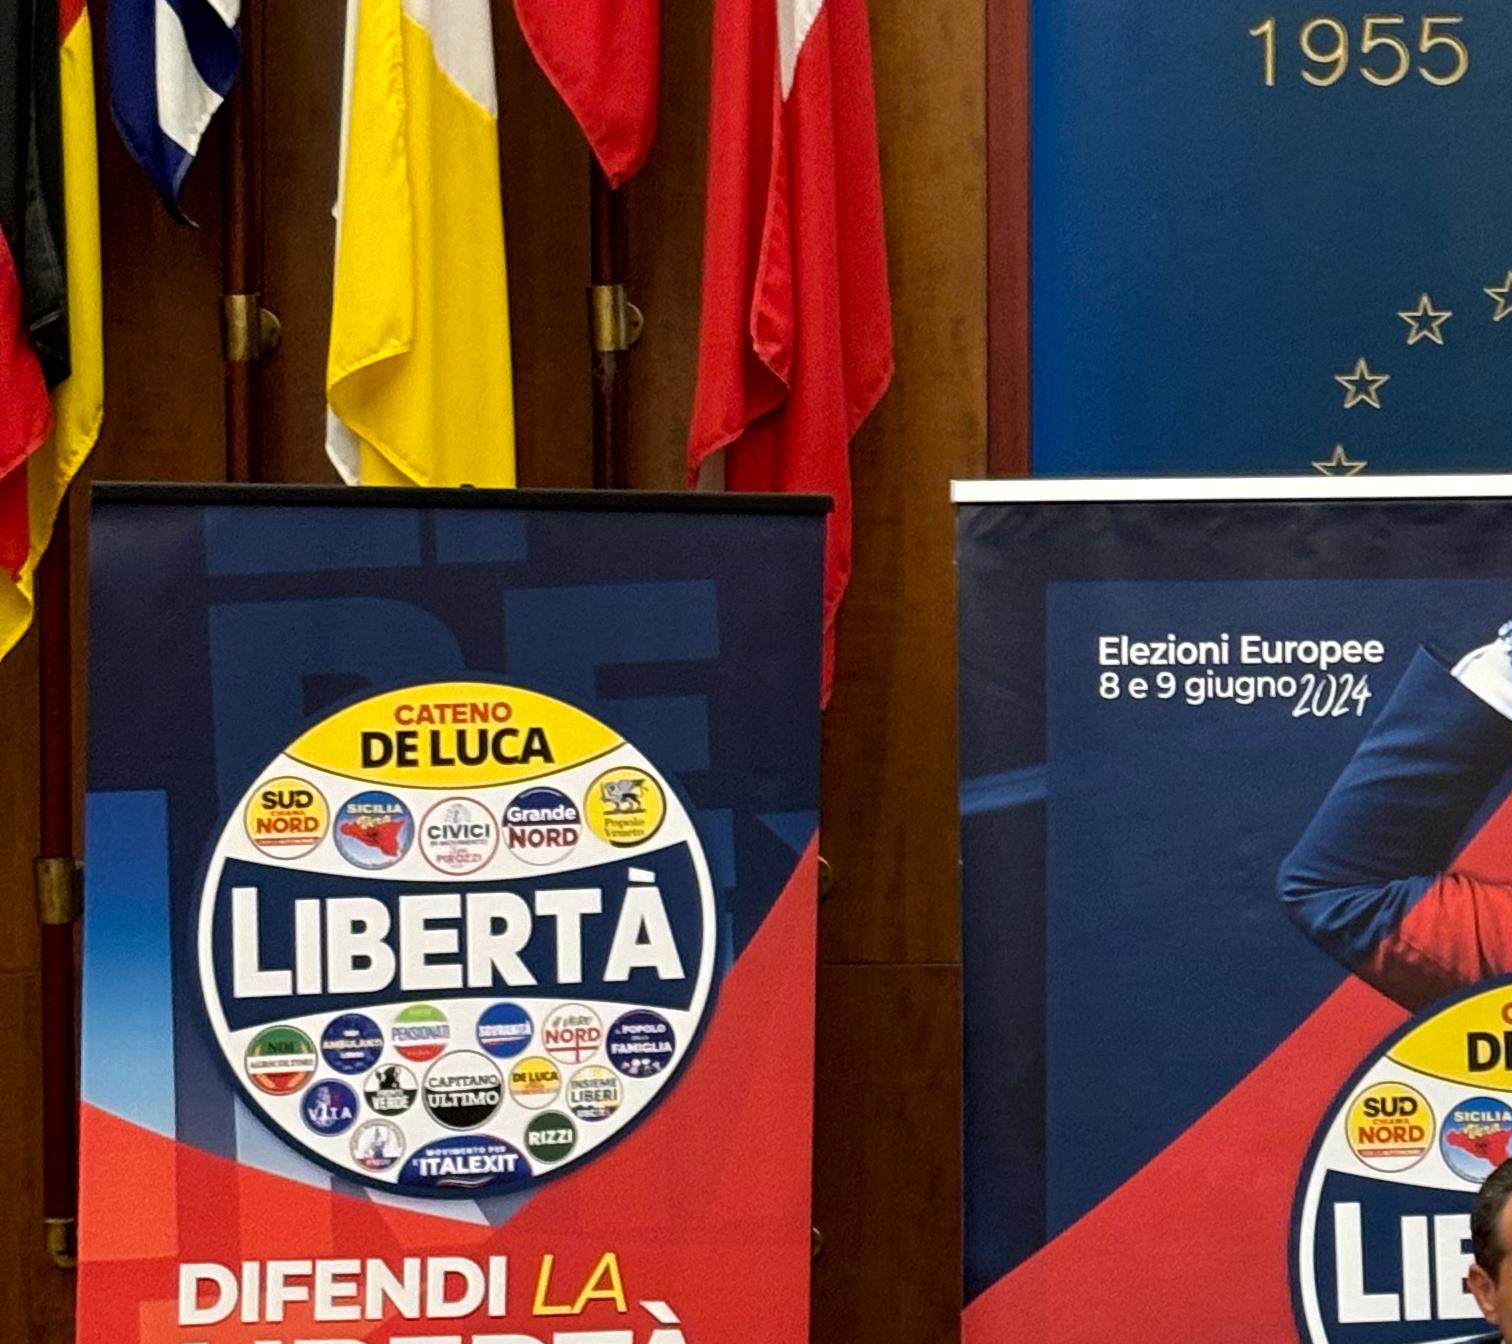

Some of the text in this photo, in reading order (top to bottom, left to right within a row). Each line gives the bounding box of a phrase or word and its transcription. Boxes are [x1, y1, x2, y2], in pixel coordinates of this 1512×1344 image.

[1247, 14, 1470, 87] 1955
[1098, 633, 1385, 671] Elezioni Europee
[1098, 668, 1372, 719] 8 e 9 giugno 2024
[393, 701, 514, 726] CATENO
[359, 726, 556, 770] DE LUCA
[262, 790, 314, 810] SUD
[346, 803, 404, 815] SICILIA
[506, 804, 577, 823] Grande
[256, 816, 319, 834] NORD
[427, 823, 490, 840] CIVICI
[508, 827, 579, 850] NORD
[231, 866, 685, 999] LIBERTÀ
[545, 1027, 601, 1045] NORD
[622, 1024, 667, 1034] POPOLO
[610, 1040, 673, 1055] FAMIGLIA
[428, 1074, 499, 1089] CAPITANO
[512, 1071, 559, 1083] DE LUCA
[428, 1091, 500, 1109] ULTIMO
[571, 1089, 618, 1104] LIBERI
[1363, 1096, 1418, 1118] SUD
[528, 1129, 574, 1146] RIZZI
[1358, 1125, 1425, 1145] NORD
[177, 1251, 629, 1328] DIFENDI LA
